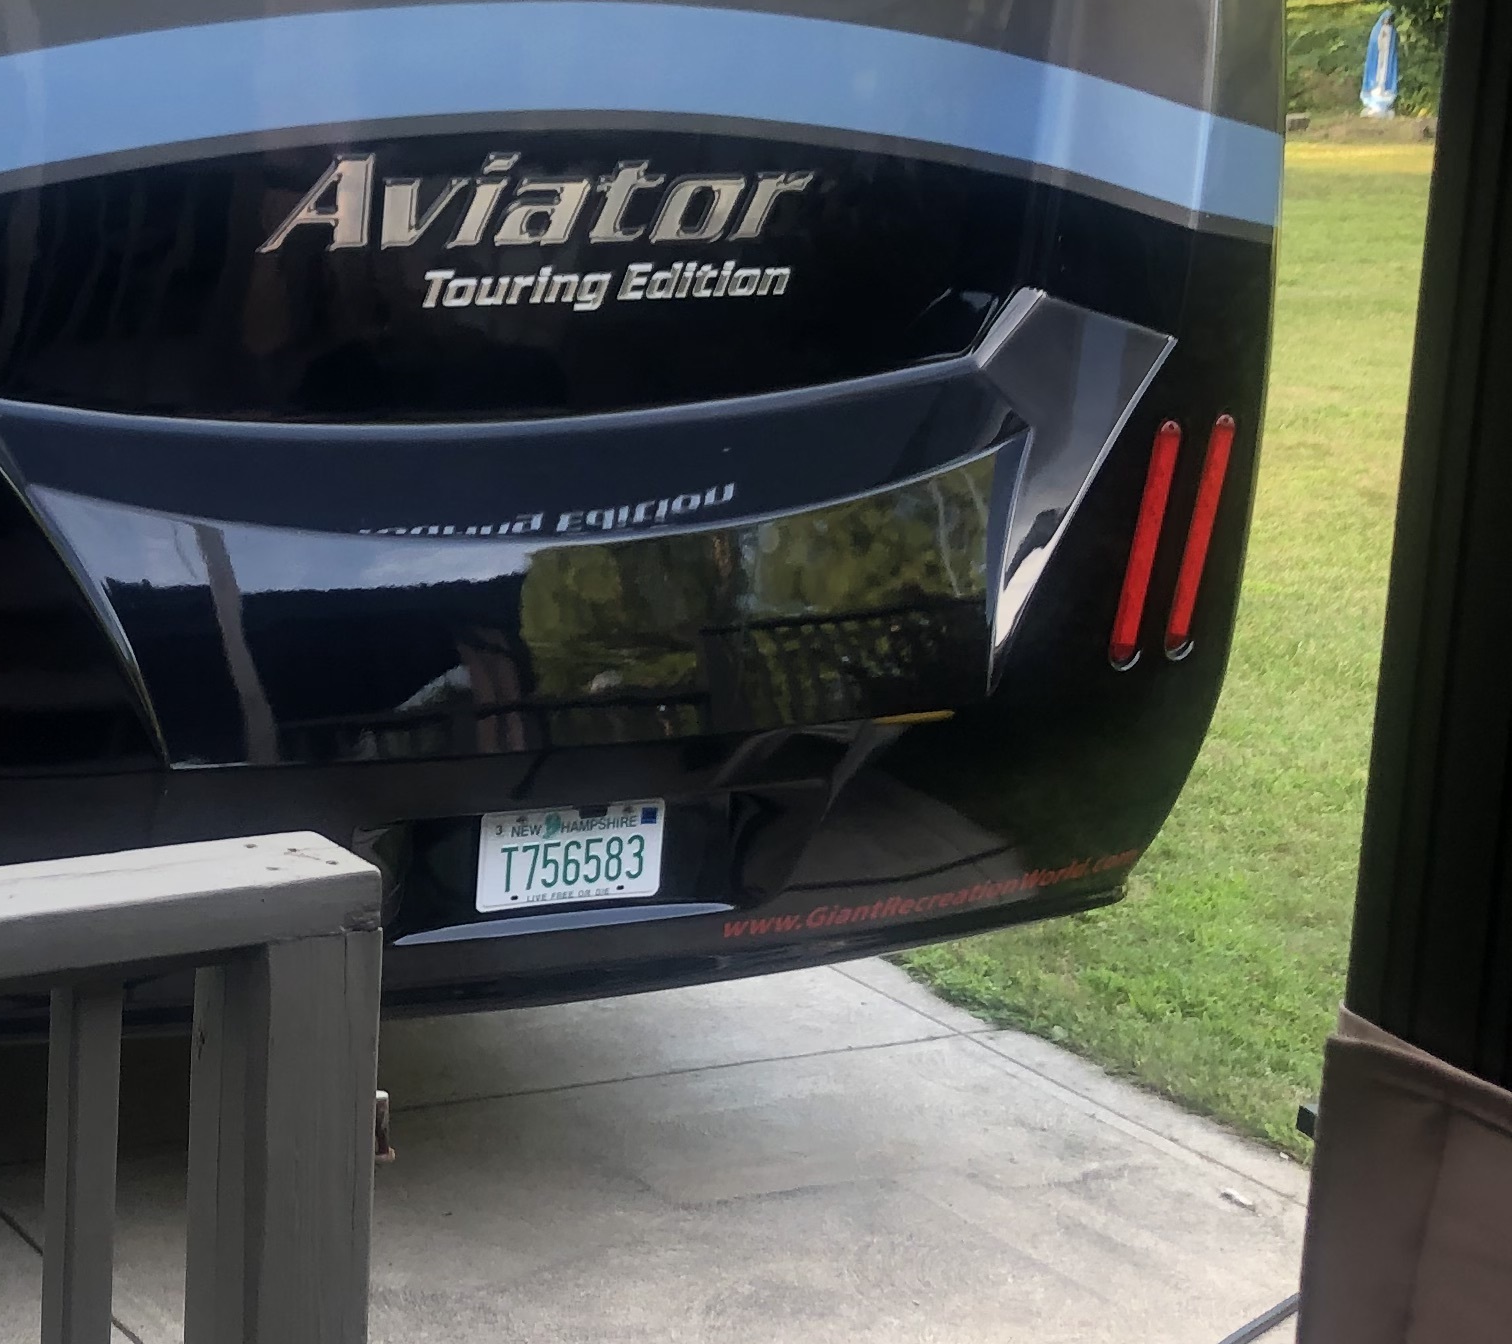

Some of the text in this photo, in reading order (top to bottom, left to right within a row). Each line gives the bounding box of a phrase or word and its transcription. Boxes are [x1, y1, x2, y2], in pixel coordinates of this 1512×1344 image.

[256, 152, 816, 254] Aviator
[421, 260, 791, 311] Touring Edition
[511, 816, 638, 838] NEW HAMPSHIRE
[501, 834, 645, 893] T756583
[526, 887, 610, 903] LIVE FREE OR DIE
